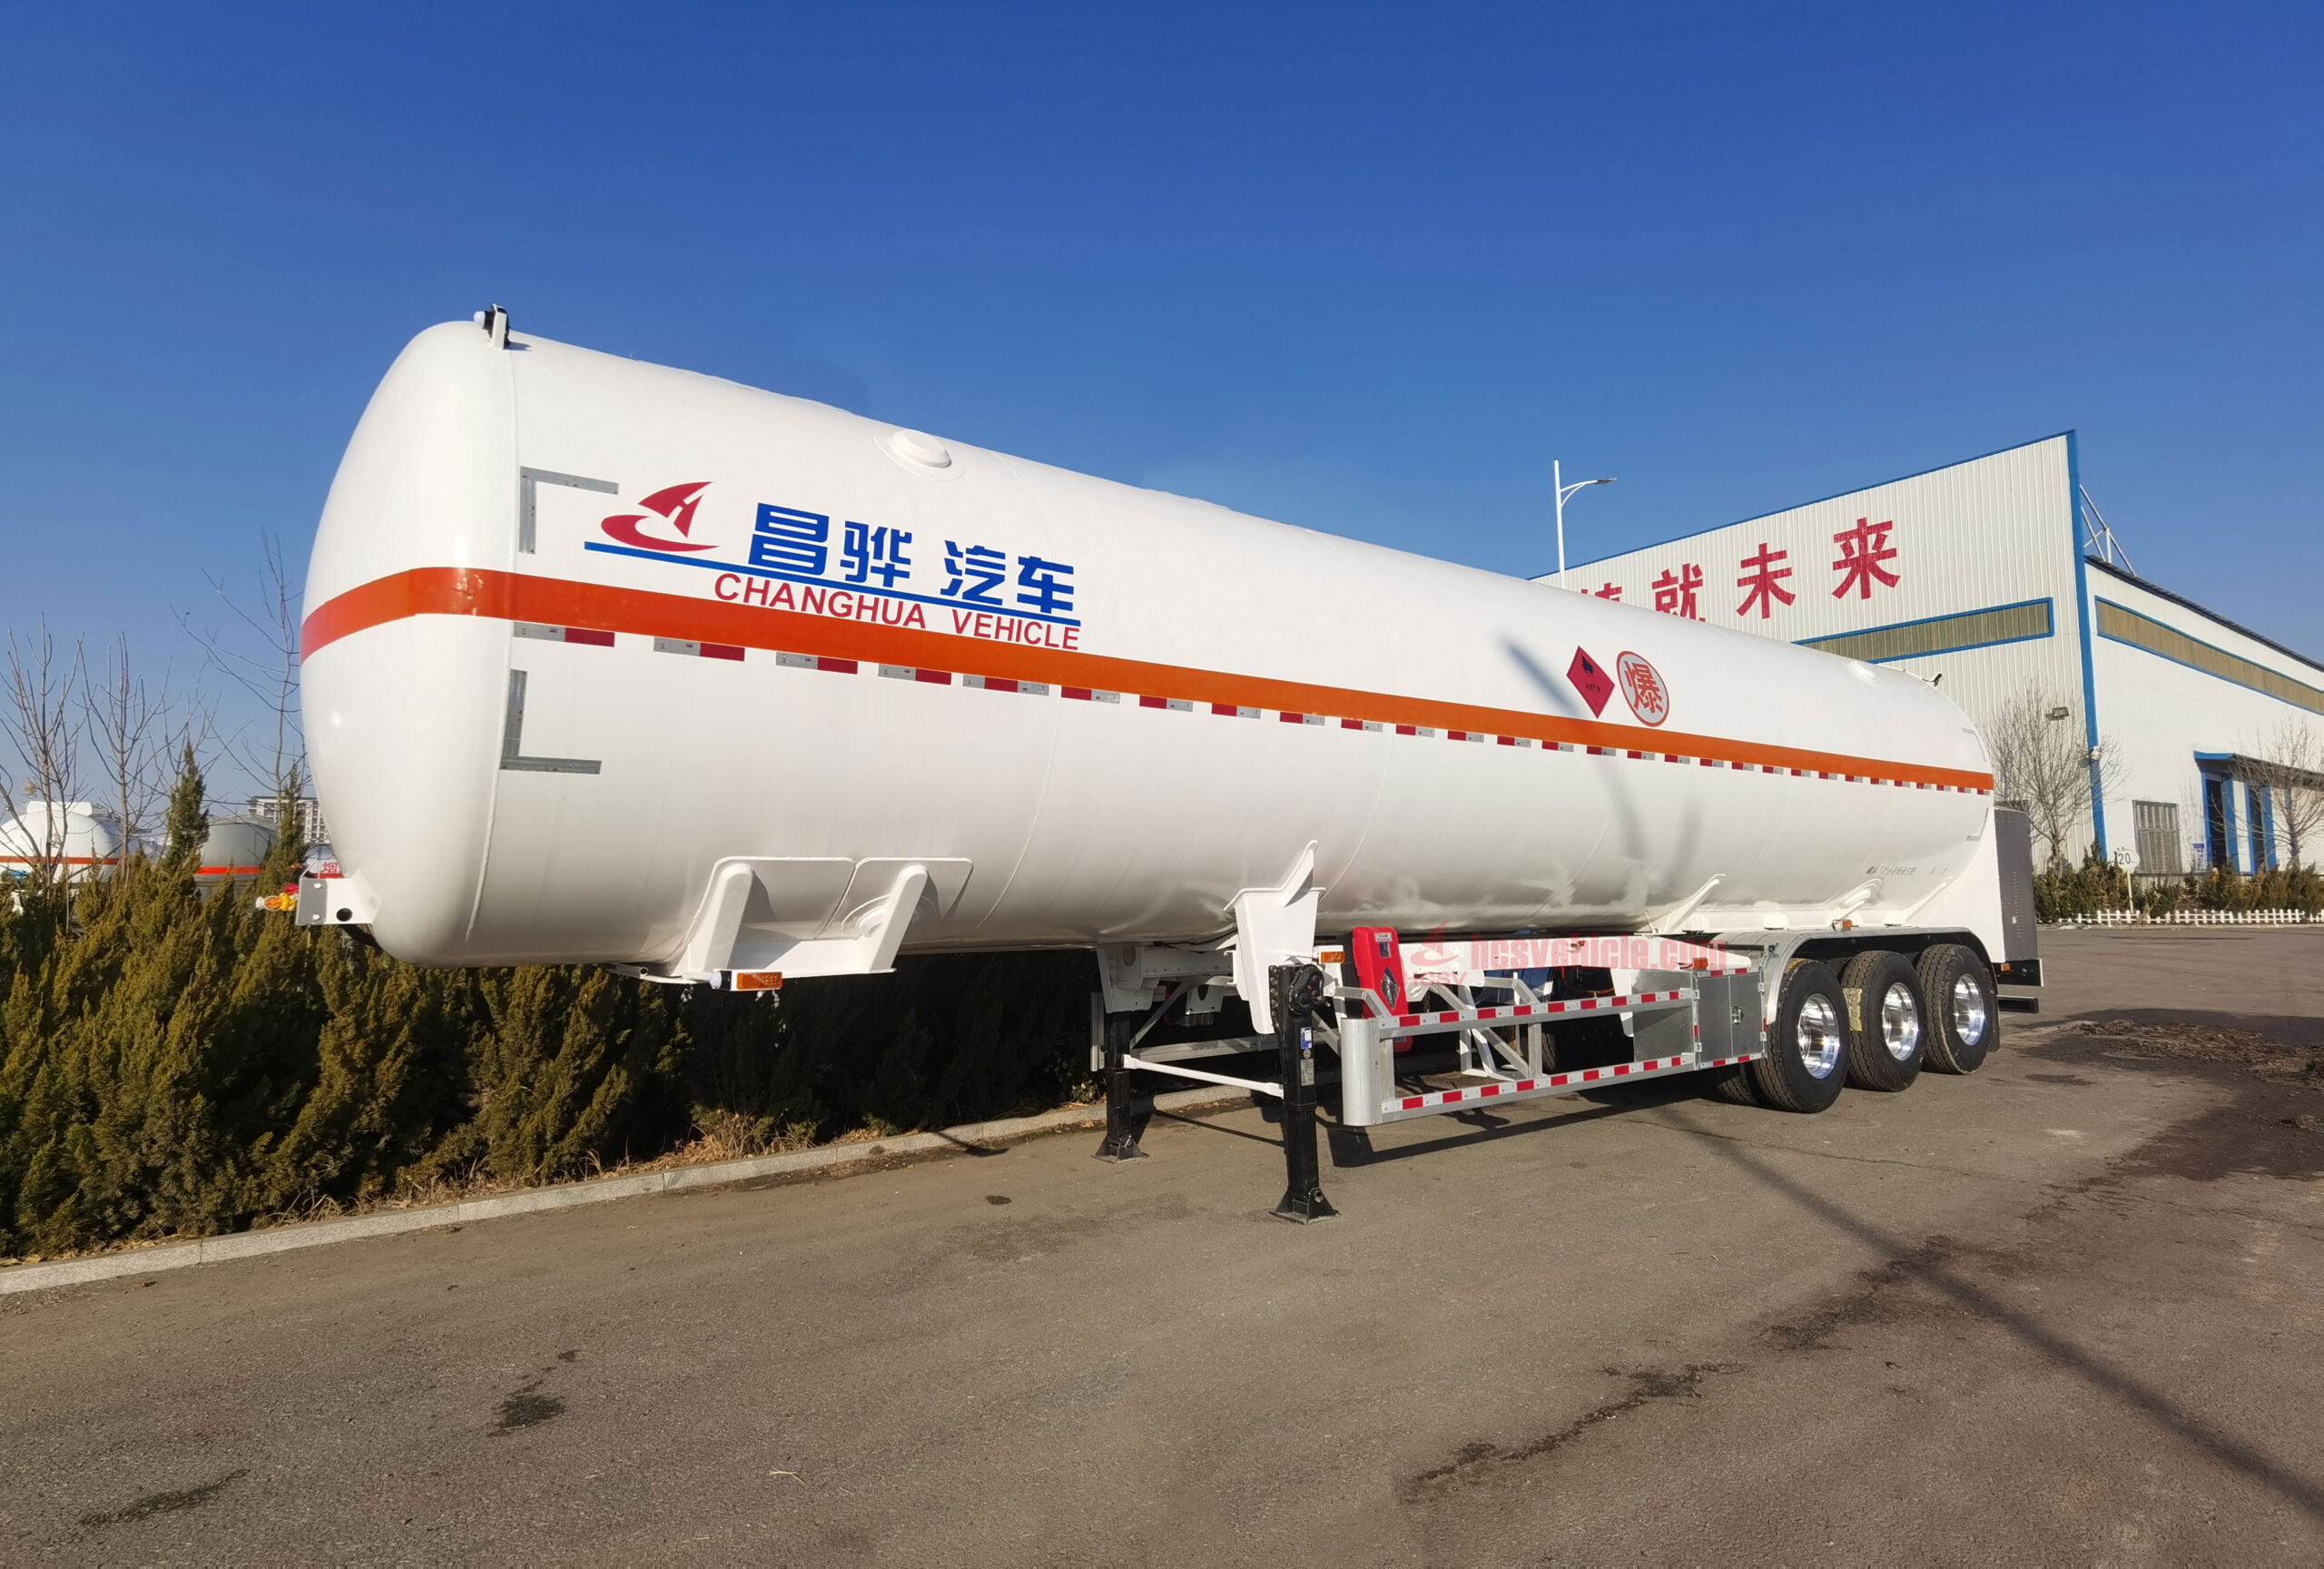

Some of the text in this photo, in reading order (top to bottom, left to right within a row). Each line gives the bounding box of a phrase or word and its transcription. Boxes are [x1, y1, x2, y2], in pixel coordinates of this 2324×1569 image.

[747, 502, 1074, 615] 昌骅 汽车
[1581, 518, 1900, 623] 就未来
[714, 573, 1081, 651] CHANGHUA VEHICLE
[1623, 660, 1664, 714] 爆
